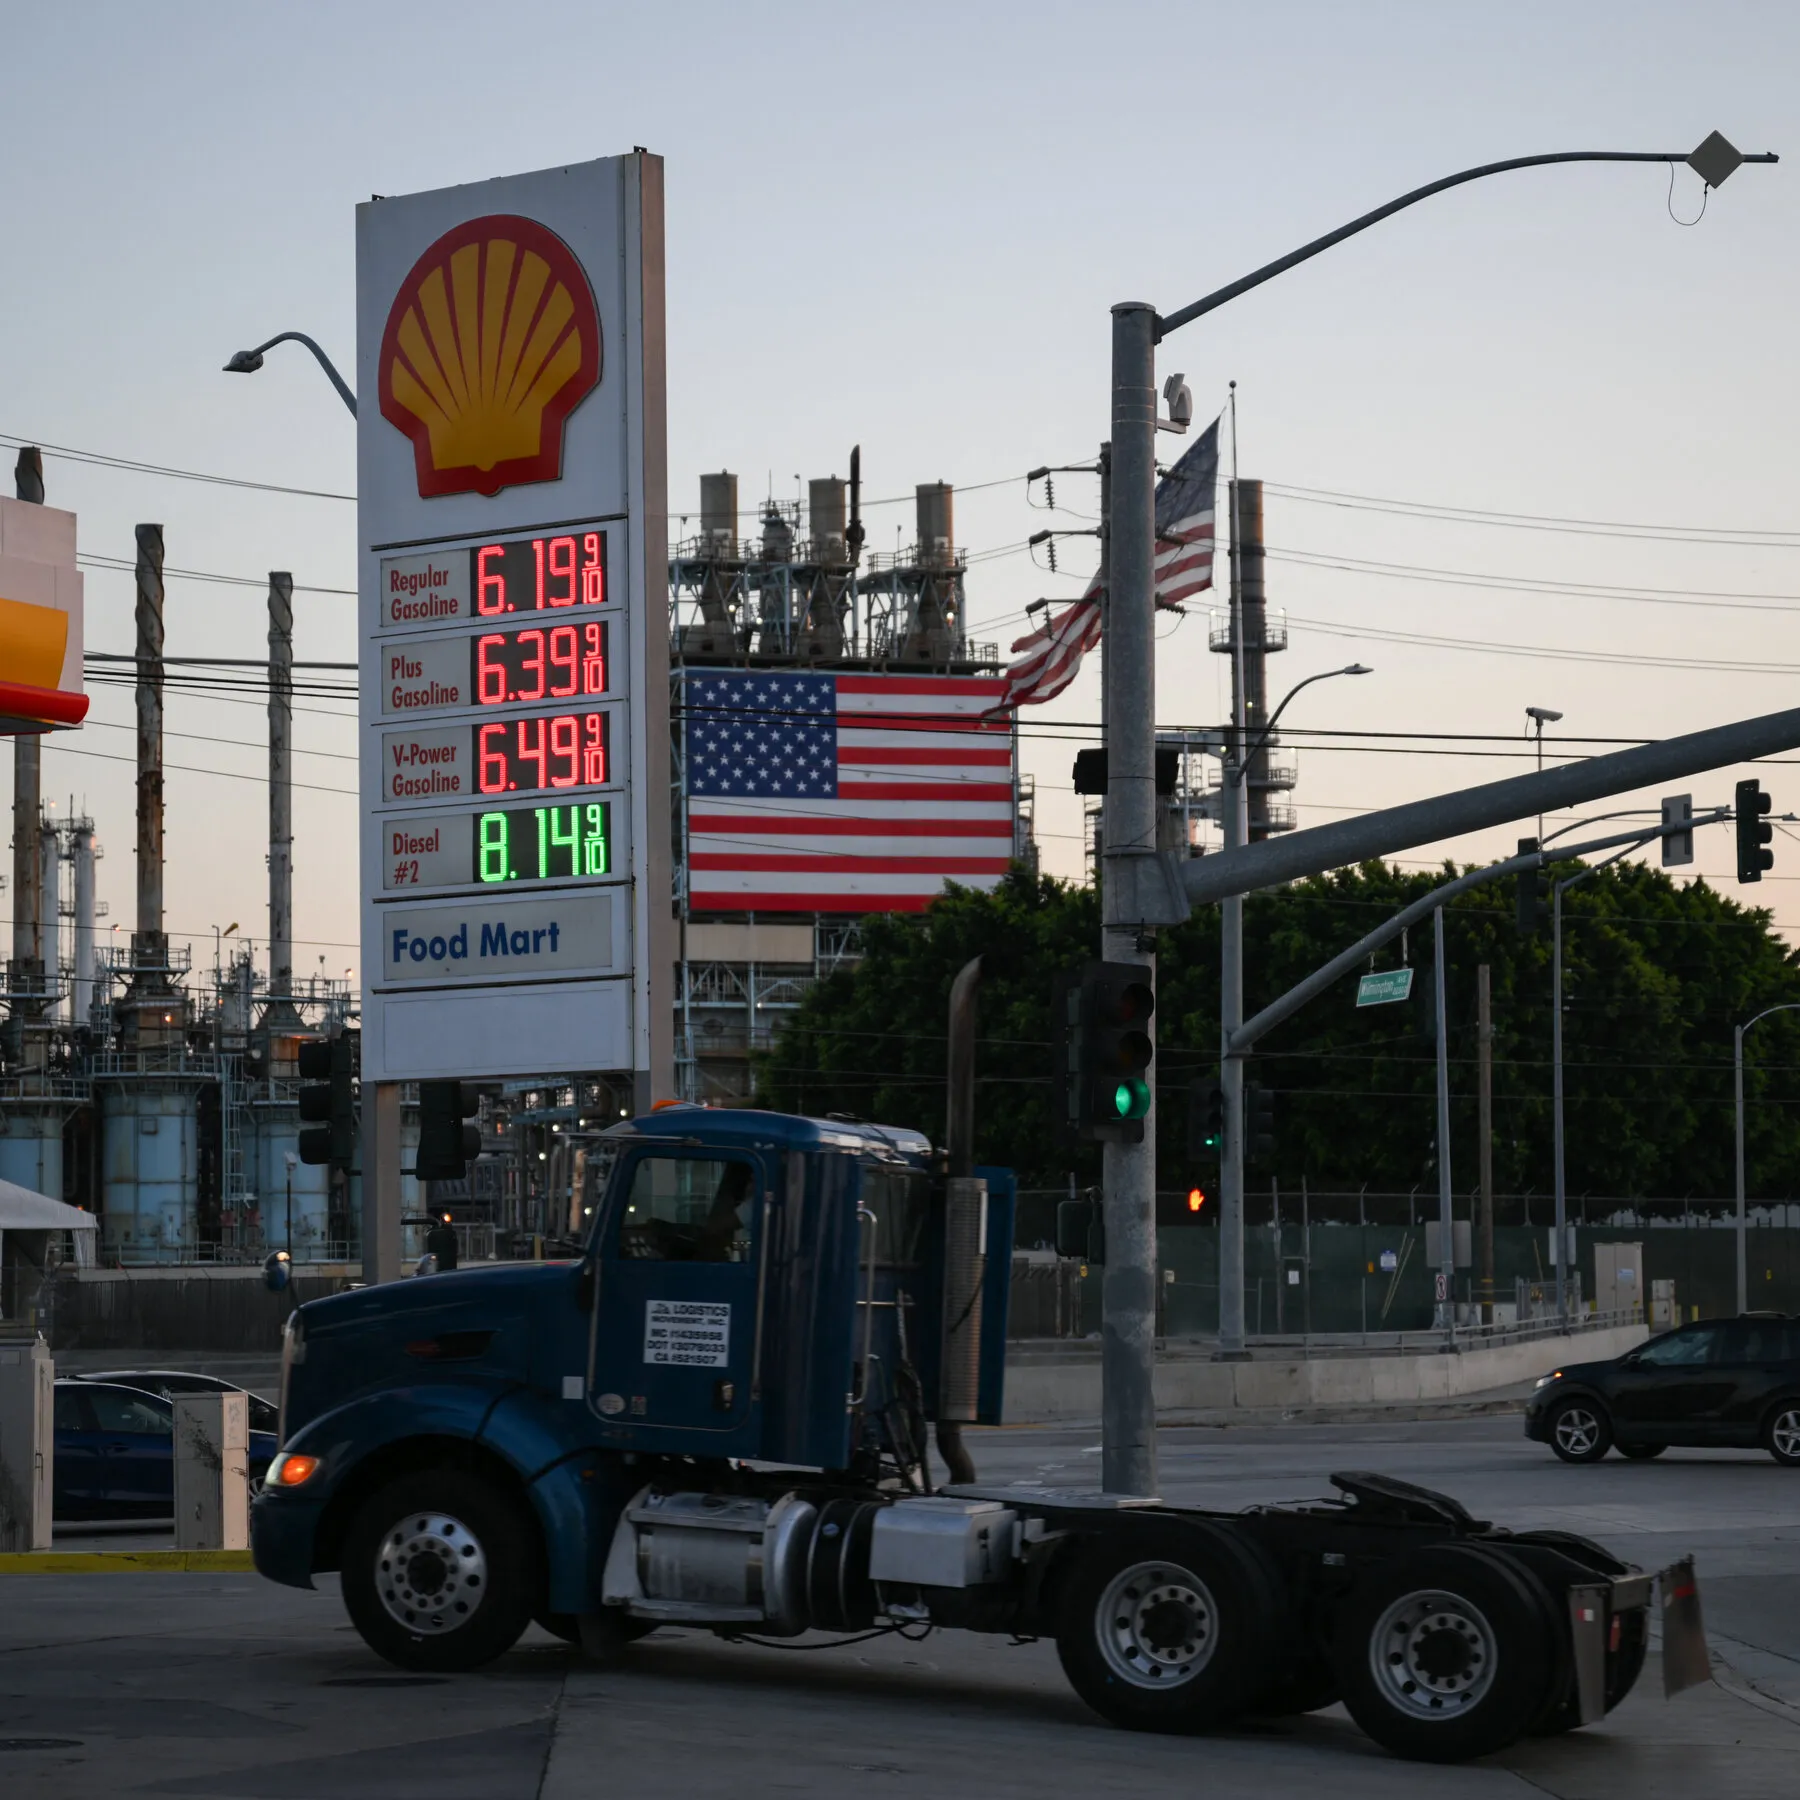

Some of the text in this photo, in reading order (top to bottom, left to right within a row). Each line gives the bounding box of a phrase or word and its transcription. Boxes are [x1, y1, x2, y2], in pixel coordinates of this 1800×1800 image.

[390, 566, 449, 596] Regular
[477, 536, 577, 616] 6.19
[391, 598, 459, 621] Gasoline
[391, 656, 423, 679] Plus
[478, 626, 578, 706] 6.39
[392, 686, 459, 709] Gasoline
[393, 742, 457, 768] V-Power
[479, 716, 579, 795] 6.49
[393, 774, 460, 797] Gasoline
[393, 828, 440, 856] Diesel
[480, 805, 580, 883] 8.14
[395, 860, 419, 885] #2
[393, 921, 560, 963] Food Mart
[673, 1304, 729, 1317] LOGISTICS
[647, 1340, 669, 1350] DOT
[654, 1352, 669, 1362] CA
